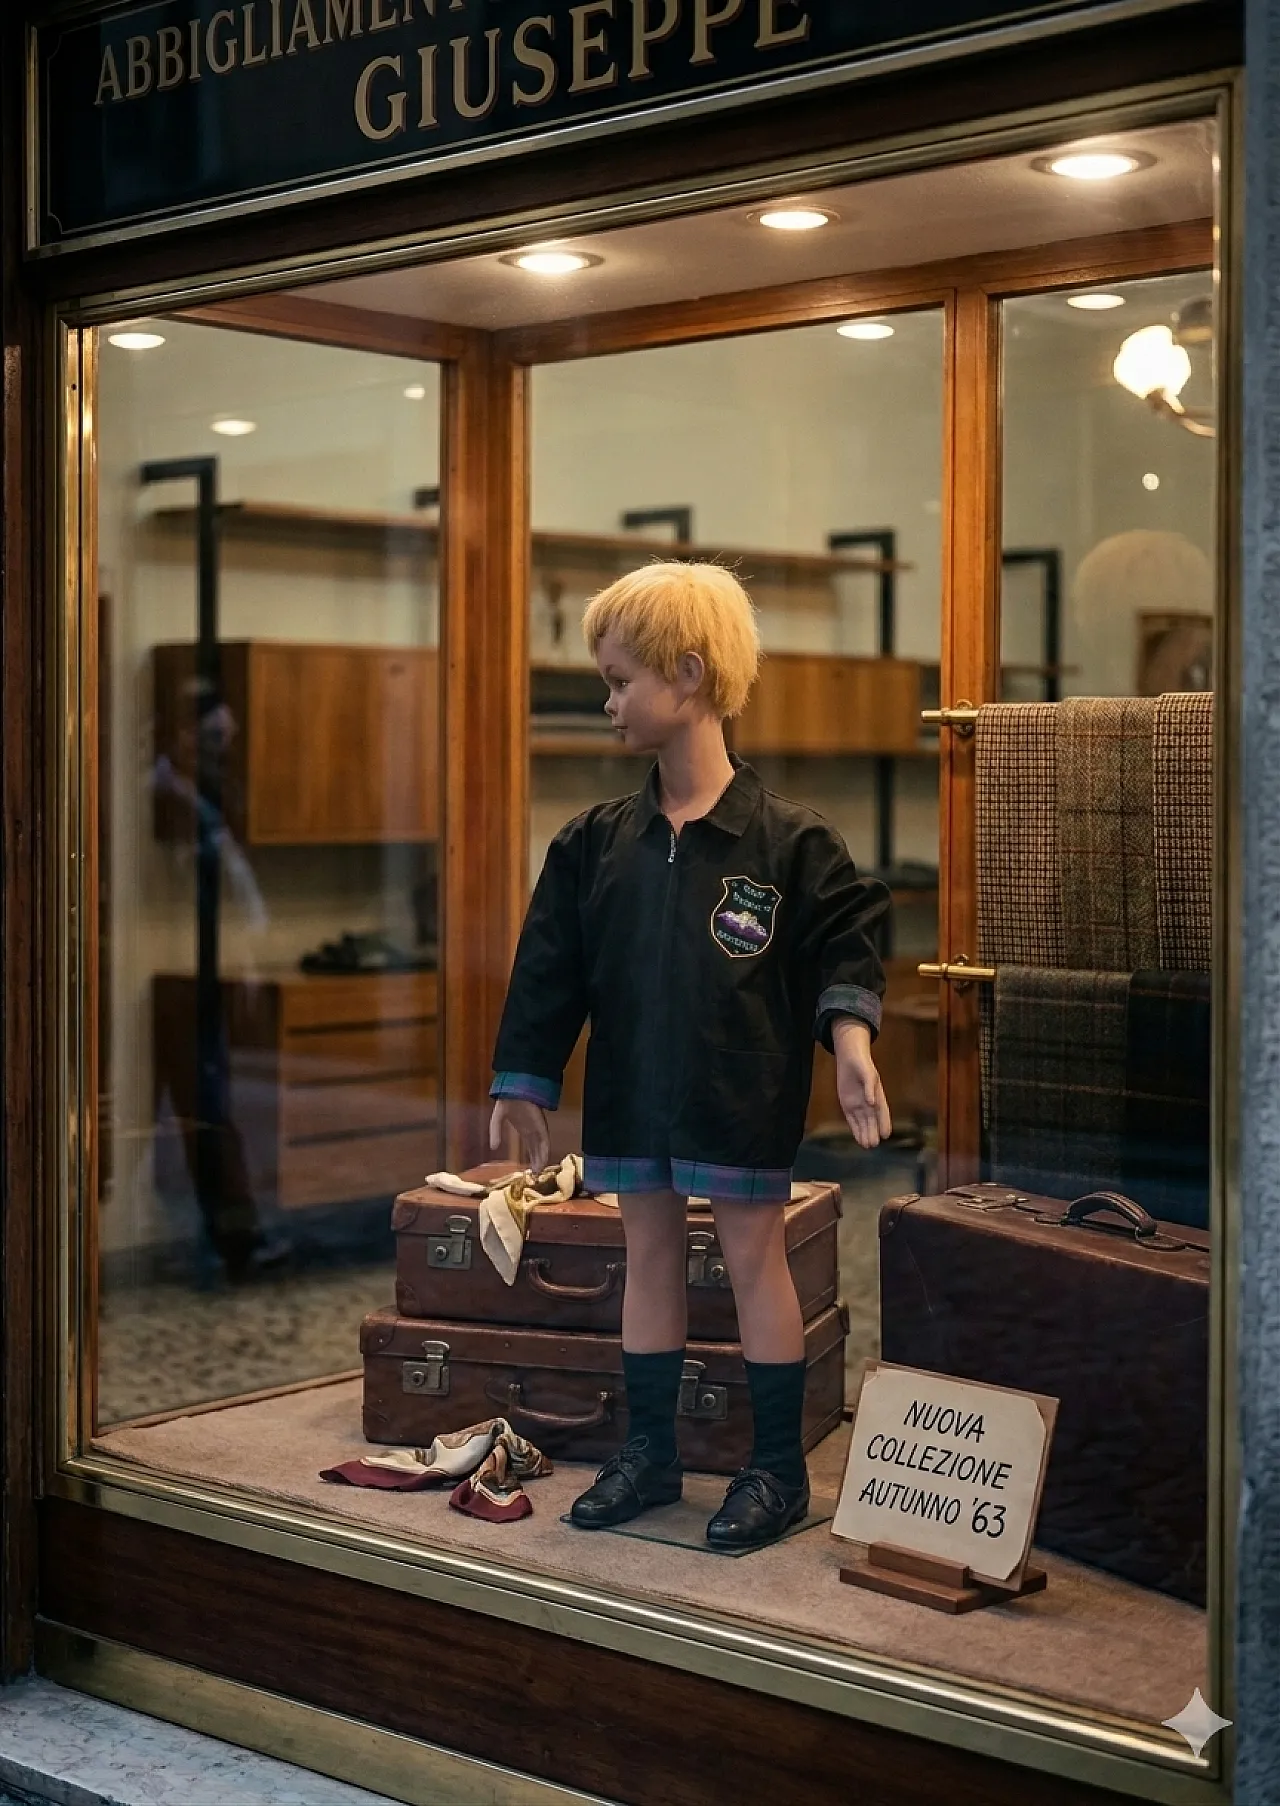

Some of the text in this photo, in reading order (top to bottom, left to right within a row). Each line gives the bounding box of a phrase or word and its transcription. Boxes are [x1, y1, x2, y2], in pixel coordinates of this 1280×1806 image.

[94, 0, 466, 107] ABBIGLIAME
[353, 0, 811, 142] GIUSEPPE
[903, 1399, 985, 1443] NUOVA
[866, 1433, 1013, 1490] COLLEZIONE
[858, 1477, 1007, 1538] AUTUNNO '63
